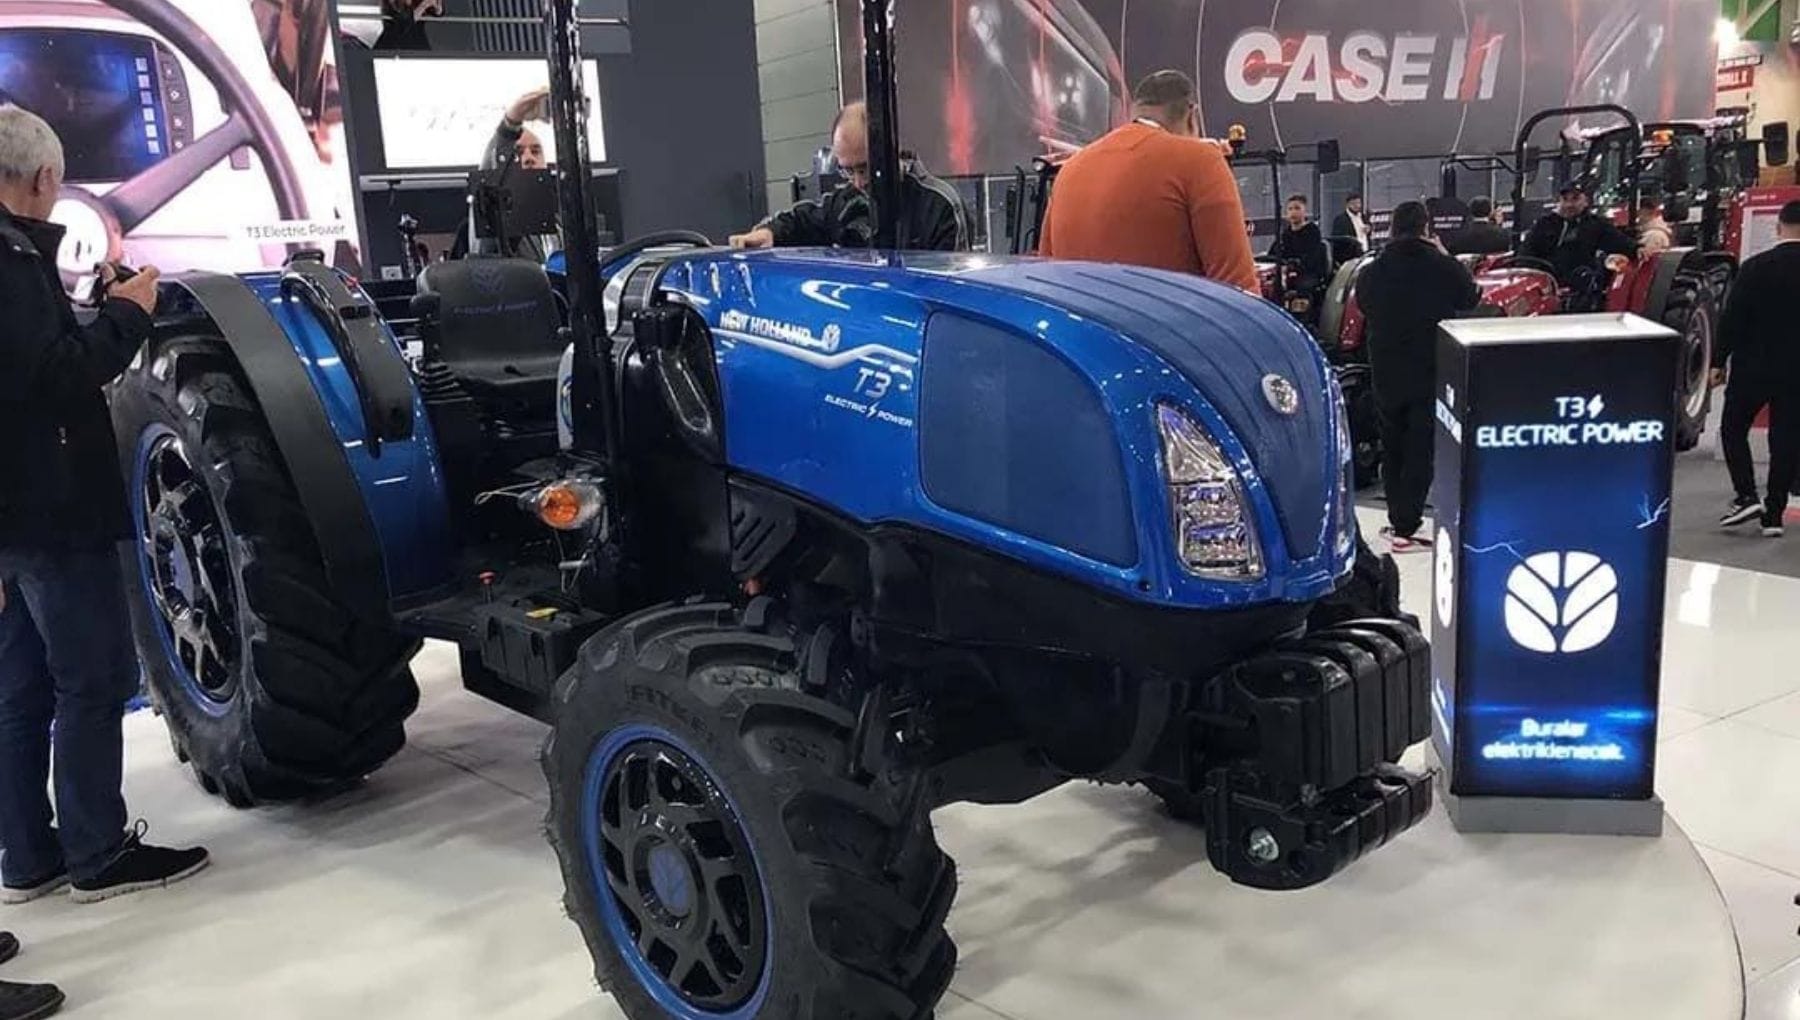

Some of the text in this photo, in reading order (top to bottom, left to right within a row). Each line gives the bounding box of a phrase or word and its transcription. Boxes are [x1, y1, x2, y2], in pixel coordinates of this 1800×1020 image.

[1224, 31, 1437, 103] CASE
[263, 225, 307, 238] Electric
[308, 223, 345, 236] Power
[750, 316, 812, 345] HOLLAND
[853, 367, 891, 398] T3
[825, 394, 913, 427] ELECTRIC POWER
[1555, 397, 1585, 418] T3
[1476, 420, 1664, 447] ELECTRIC POWER
